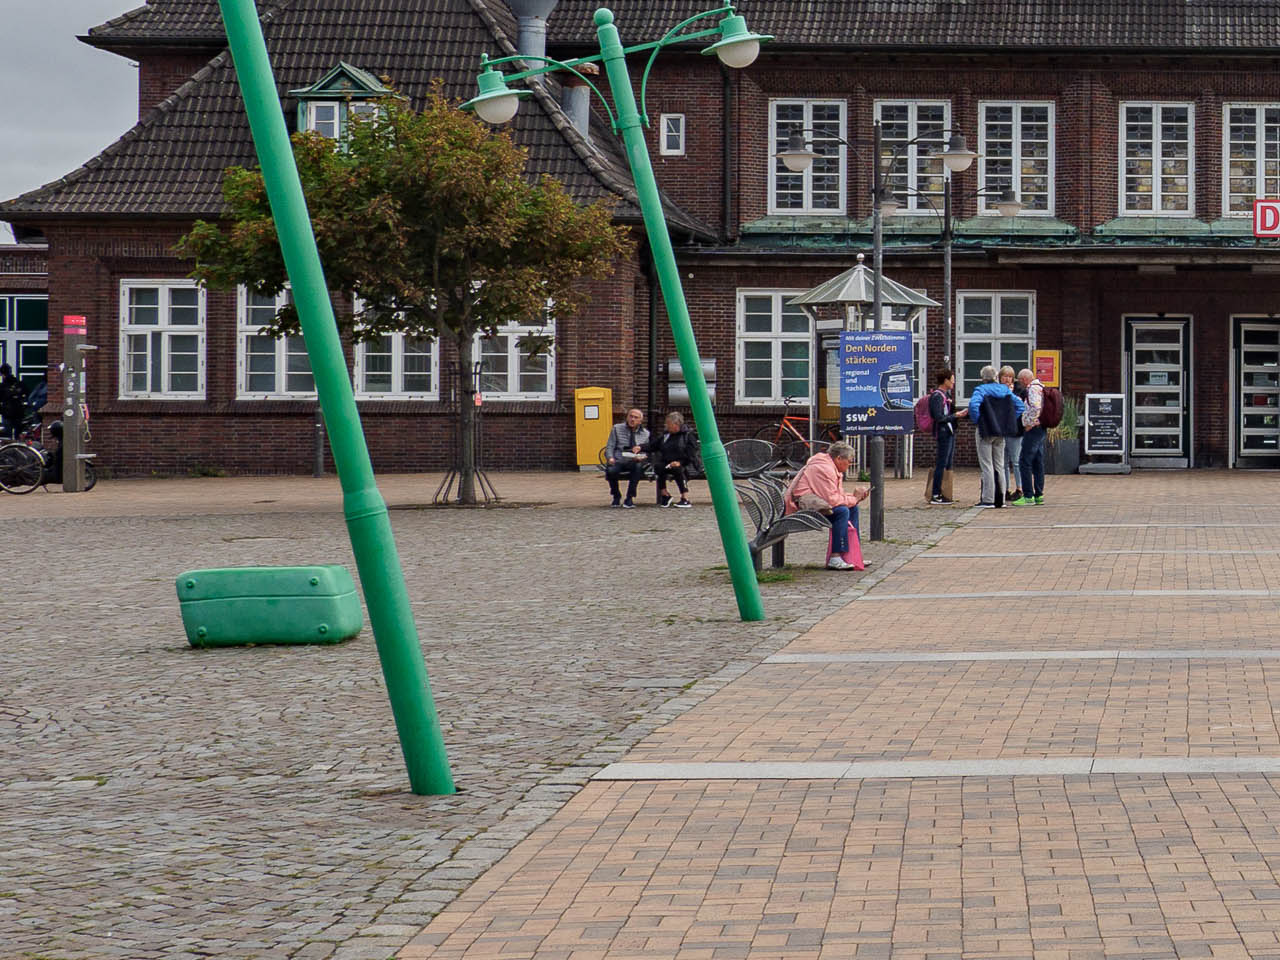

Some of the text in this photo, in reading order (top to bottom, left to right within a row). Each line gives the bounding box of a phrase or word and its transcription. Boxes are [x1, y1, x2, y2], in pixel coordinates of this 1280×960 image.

[845, 343, 897, 353] Den Norden
[845, 355, 878, 364] stärken
[845, 369, 870, 377] regional
[845, 384, 878, 393] nachhaltig
[845, 413, 868, 422] SSW
